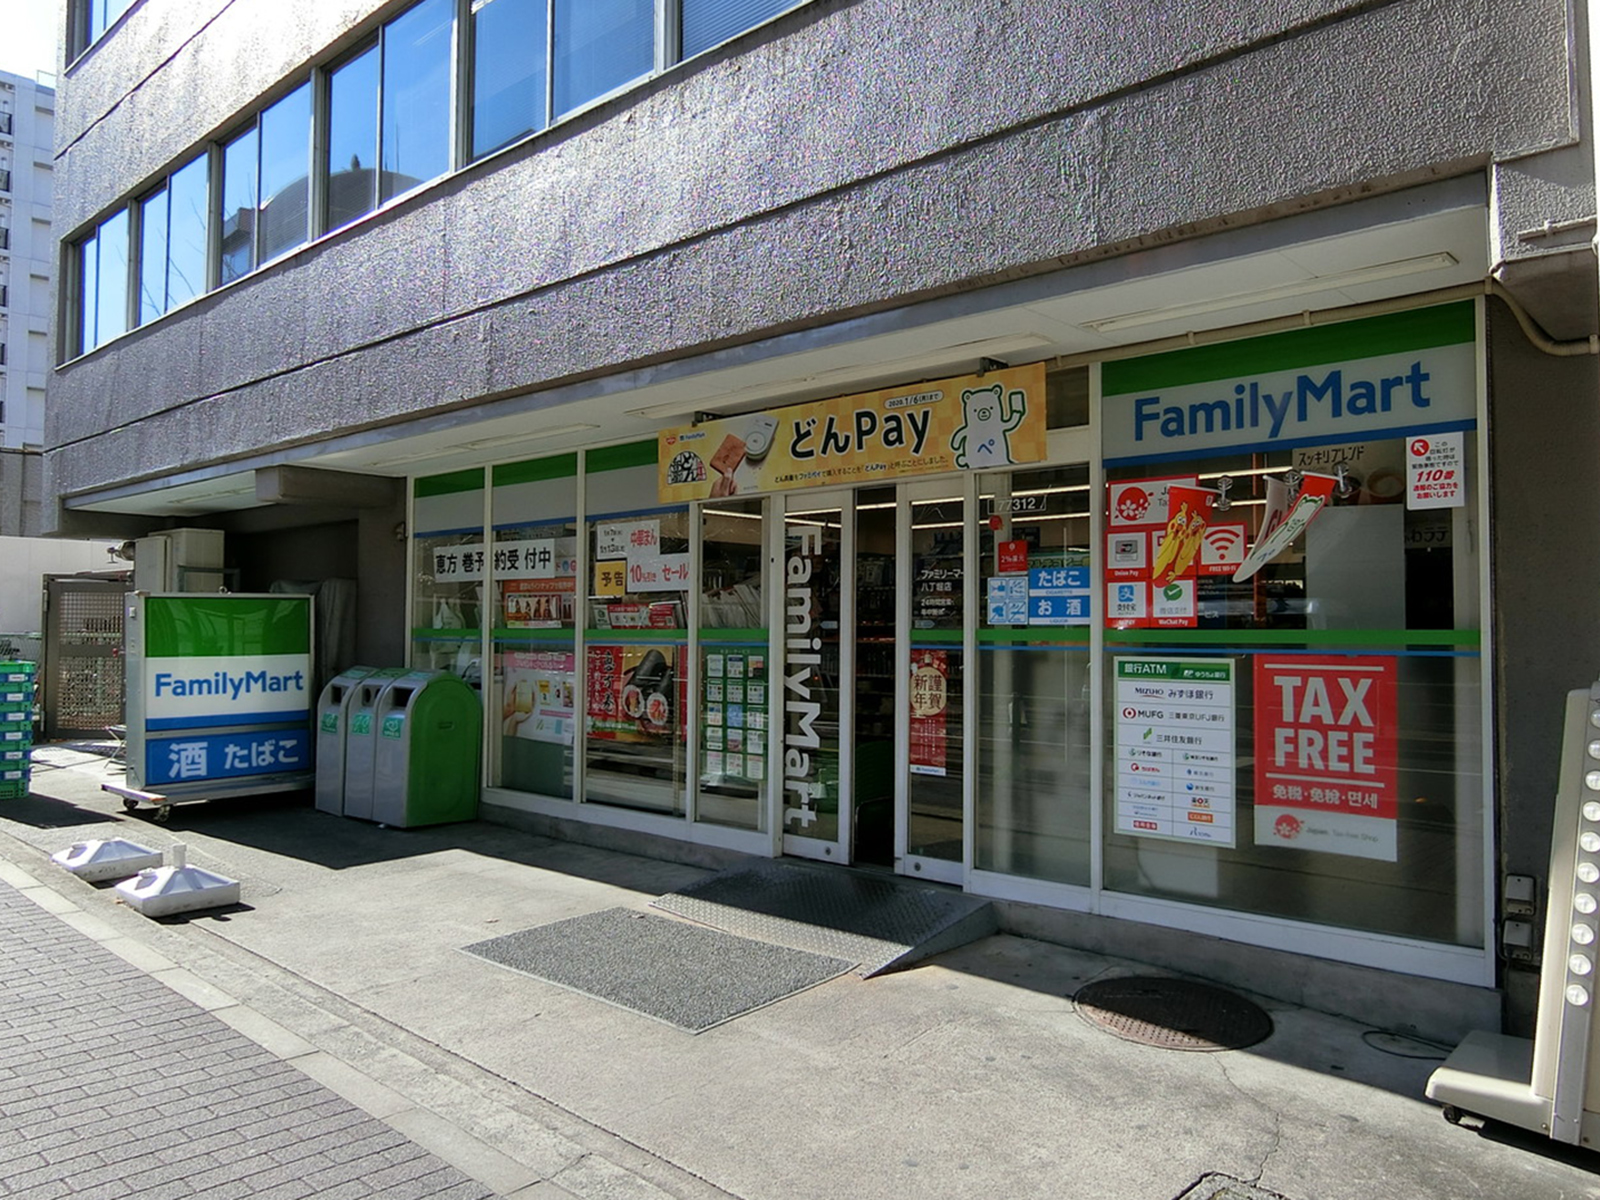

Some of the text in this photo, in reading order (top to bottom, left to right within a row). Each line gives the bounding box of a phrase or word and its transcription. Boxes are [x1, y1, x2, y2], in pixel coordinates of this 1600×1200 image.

[1134, 361, 1431, 441] FamilyMart
[791, 409, 931, 459] どんPay
[1417, 469, 1455, 483] 110番
[601, 571, 624, 587] 予告
[1037, 570, 1082, 587] たばこ
[784, 526, 822, 828] FamilyMart
[1124, 663, 1167, 675] 銀行ATM
[154, 670, 304, 700] FamilyMart
[1135, 687, 1214, 701] MIZUHO みずほ銀行
[1273, 675, 1374, 728] TAX
[1137, 710, 1164, 719] MUFG
[1156, 734, 1203, 745] 三井住友銀行
[168, 738, 300, 779] 酒 たばこ
[1274, 728, 1376, 775] FREE
